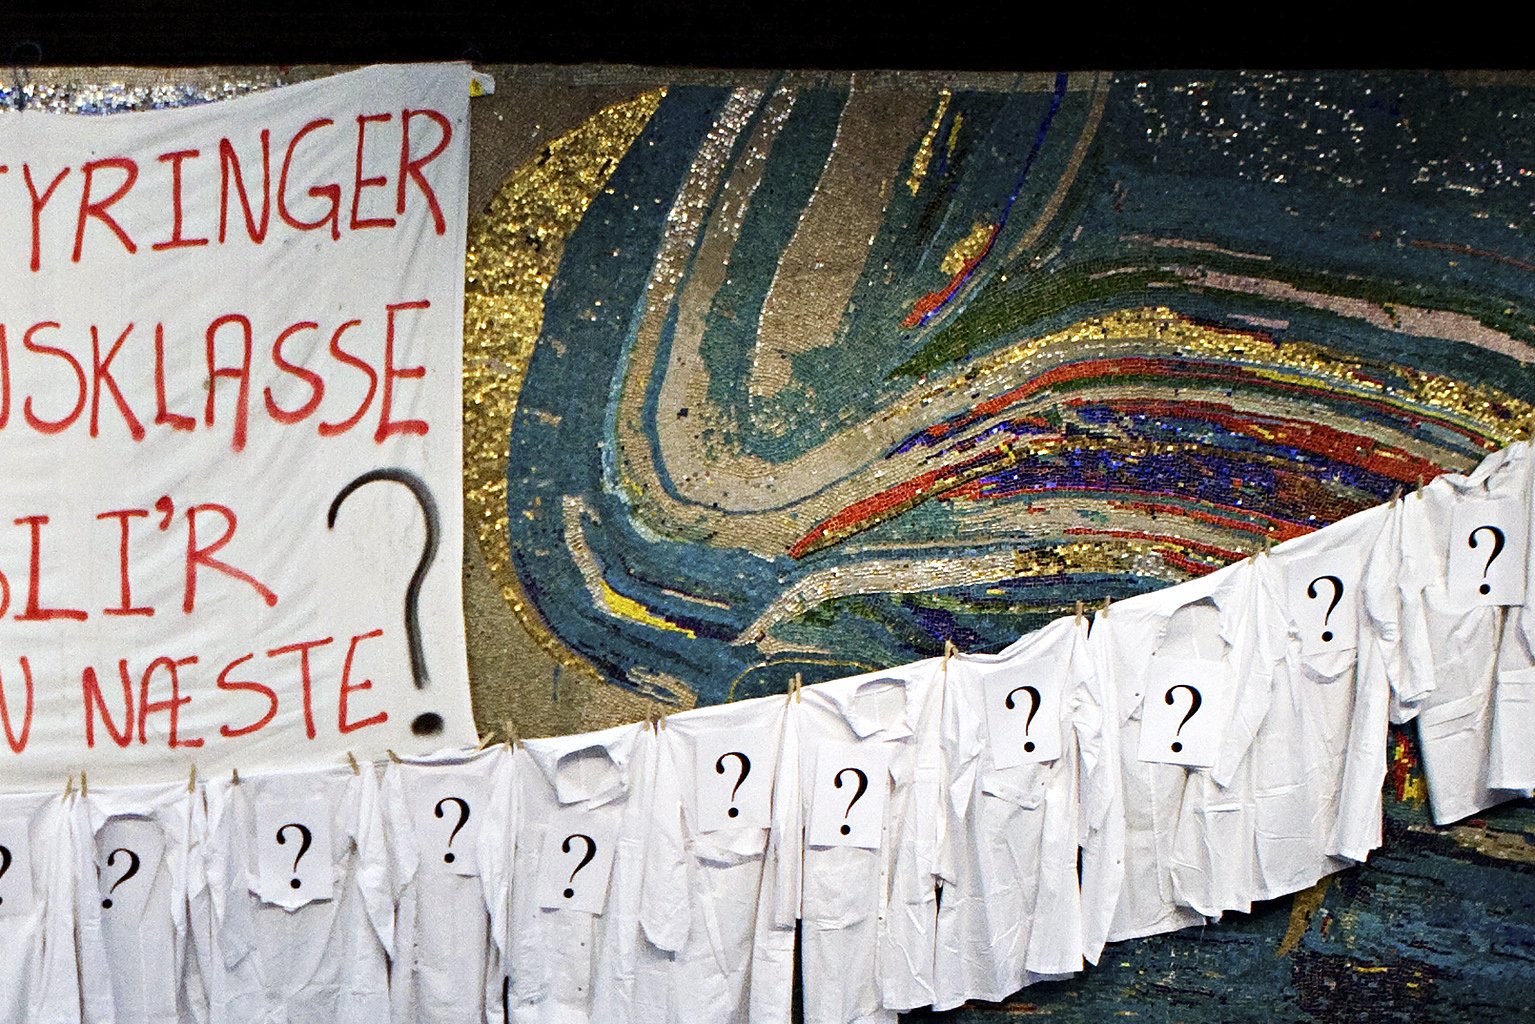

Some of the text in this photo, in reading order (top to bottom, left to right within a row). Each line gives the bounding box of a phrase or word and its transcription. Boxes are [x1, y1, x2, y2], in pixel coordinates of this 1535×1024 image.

[1468, 525, 1506, 596] ?
[1307, 575, 1345, 643] ?
[81, 627, 390, 749] NÆSTE
[1005, 685, 1042, 753] ?
[1164, 684, 1202, 753] ?
[715, 751, 751, 819] ?
[833, 767, 869, 836] ?
[275, 823, 313, 890] ?
[434, 796, 471, 865] ?
[99, 847, 141, 910] ?
[561, 833, 598, 899] ?
